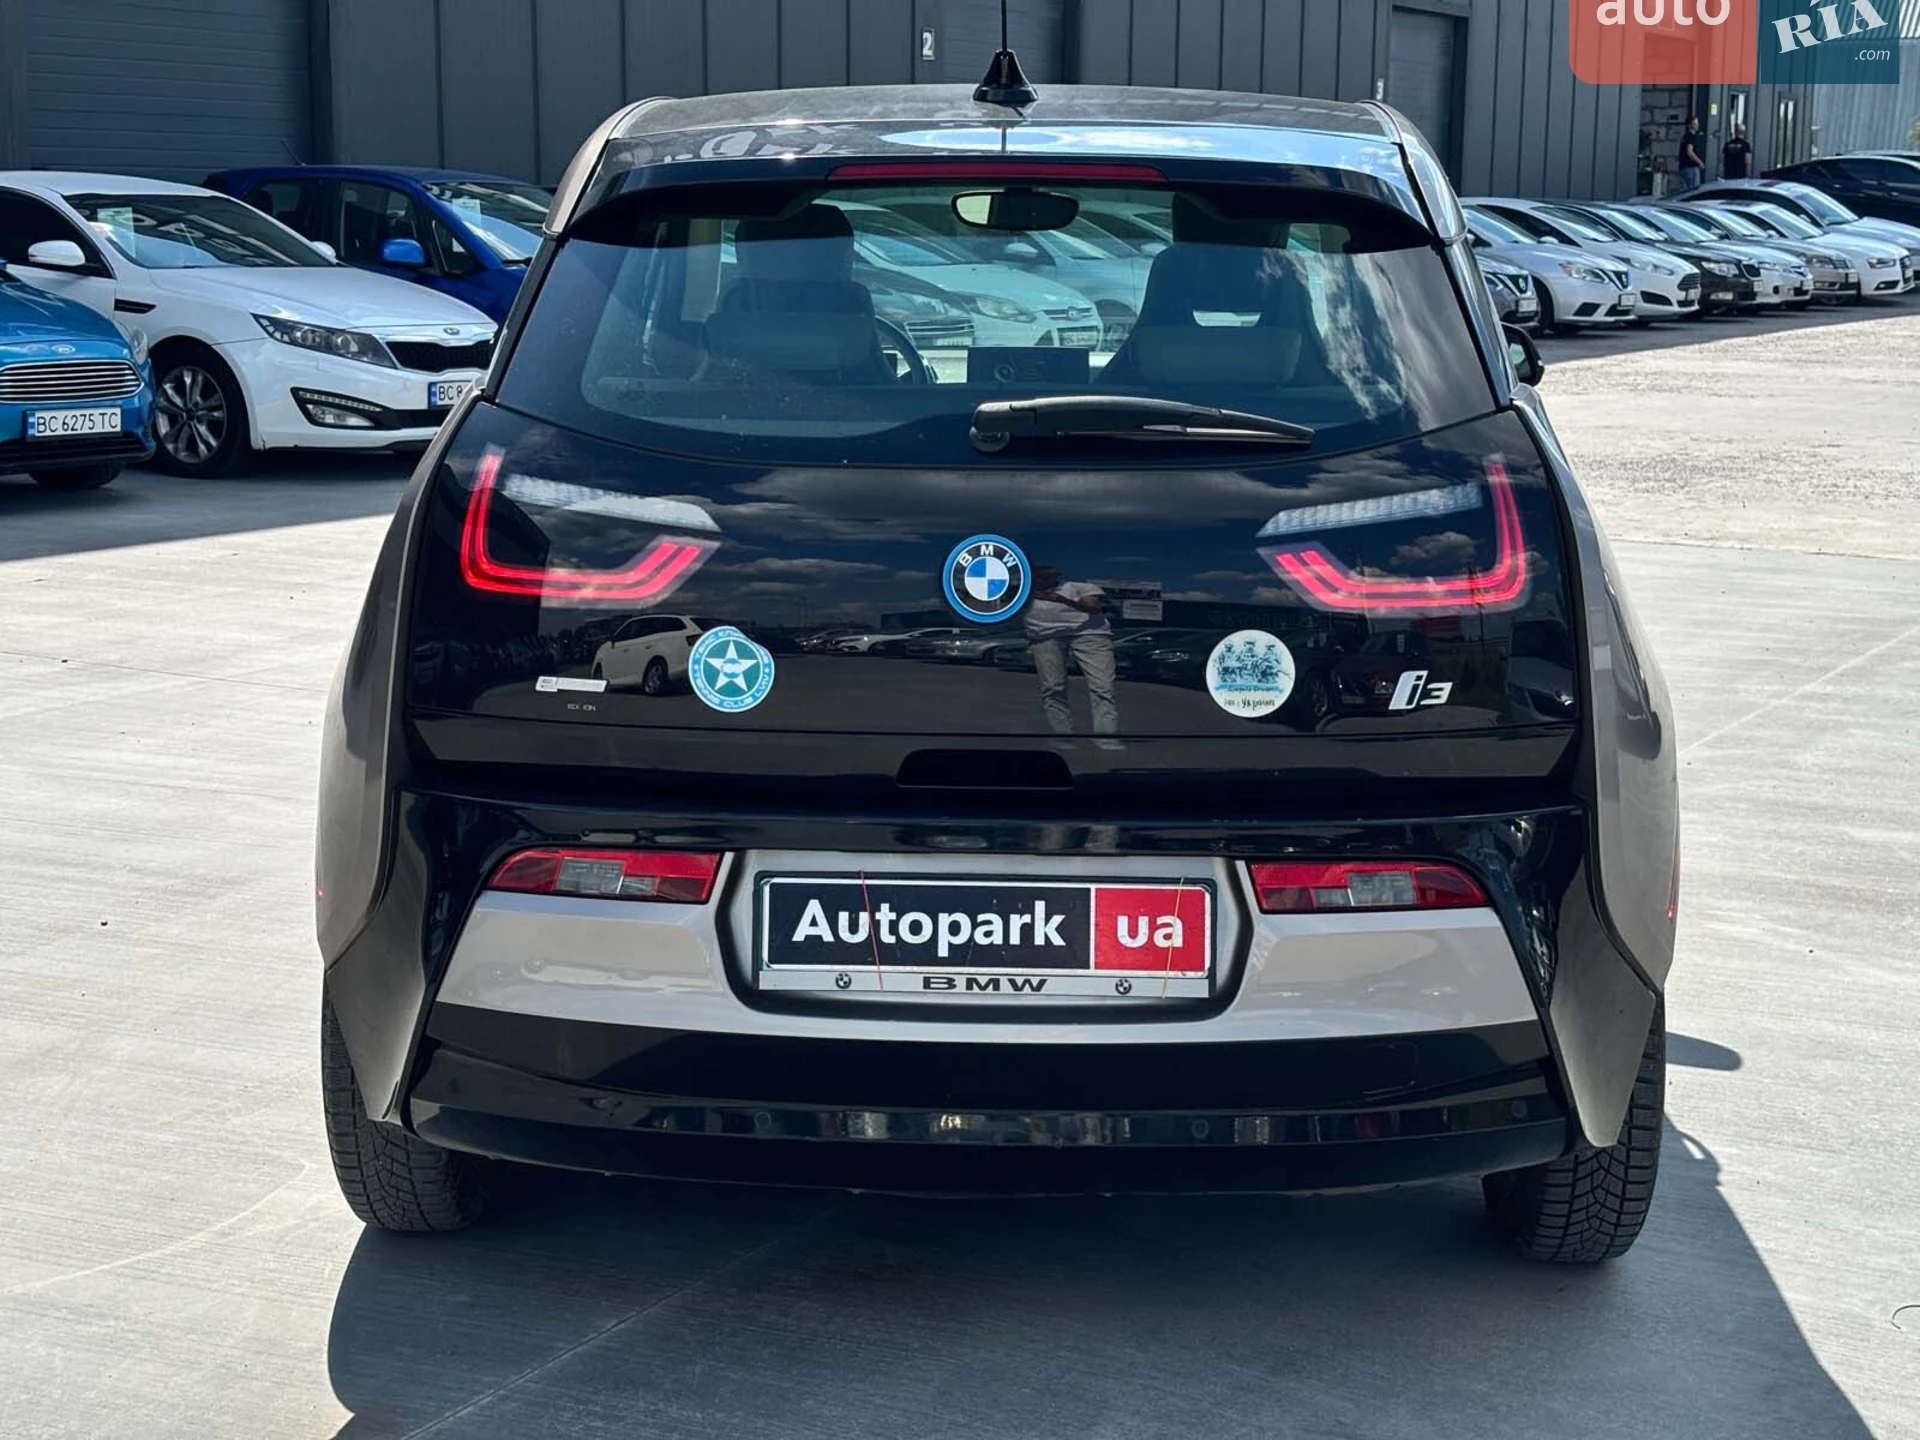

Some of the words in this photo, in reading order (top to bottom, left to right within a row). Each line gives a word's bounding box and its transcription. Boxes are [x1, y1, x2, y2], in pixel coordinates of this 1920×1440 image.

[922, 31, 933, 56] 2
[36, 416, 59, 434] BC
[61, 413, 96, 432] 6275
[98, 412, 119, 430] TC
[958, 544, 1018, 568] BMW
[1388, 670, 1453, 710] i3
[791, 898, 1067, 958] Autopark
[1115, 913, 1184, 949] ua
[921, 975, 1050, 994] BMW
